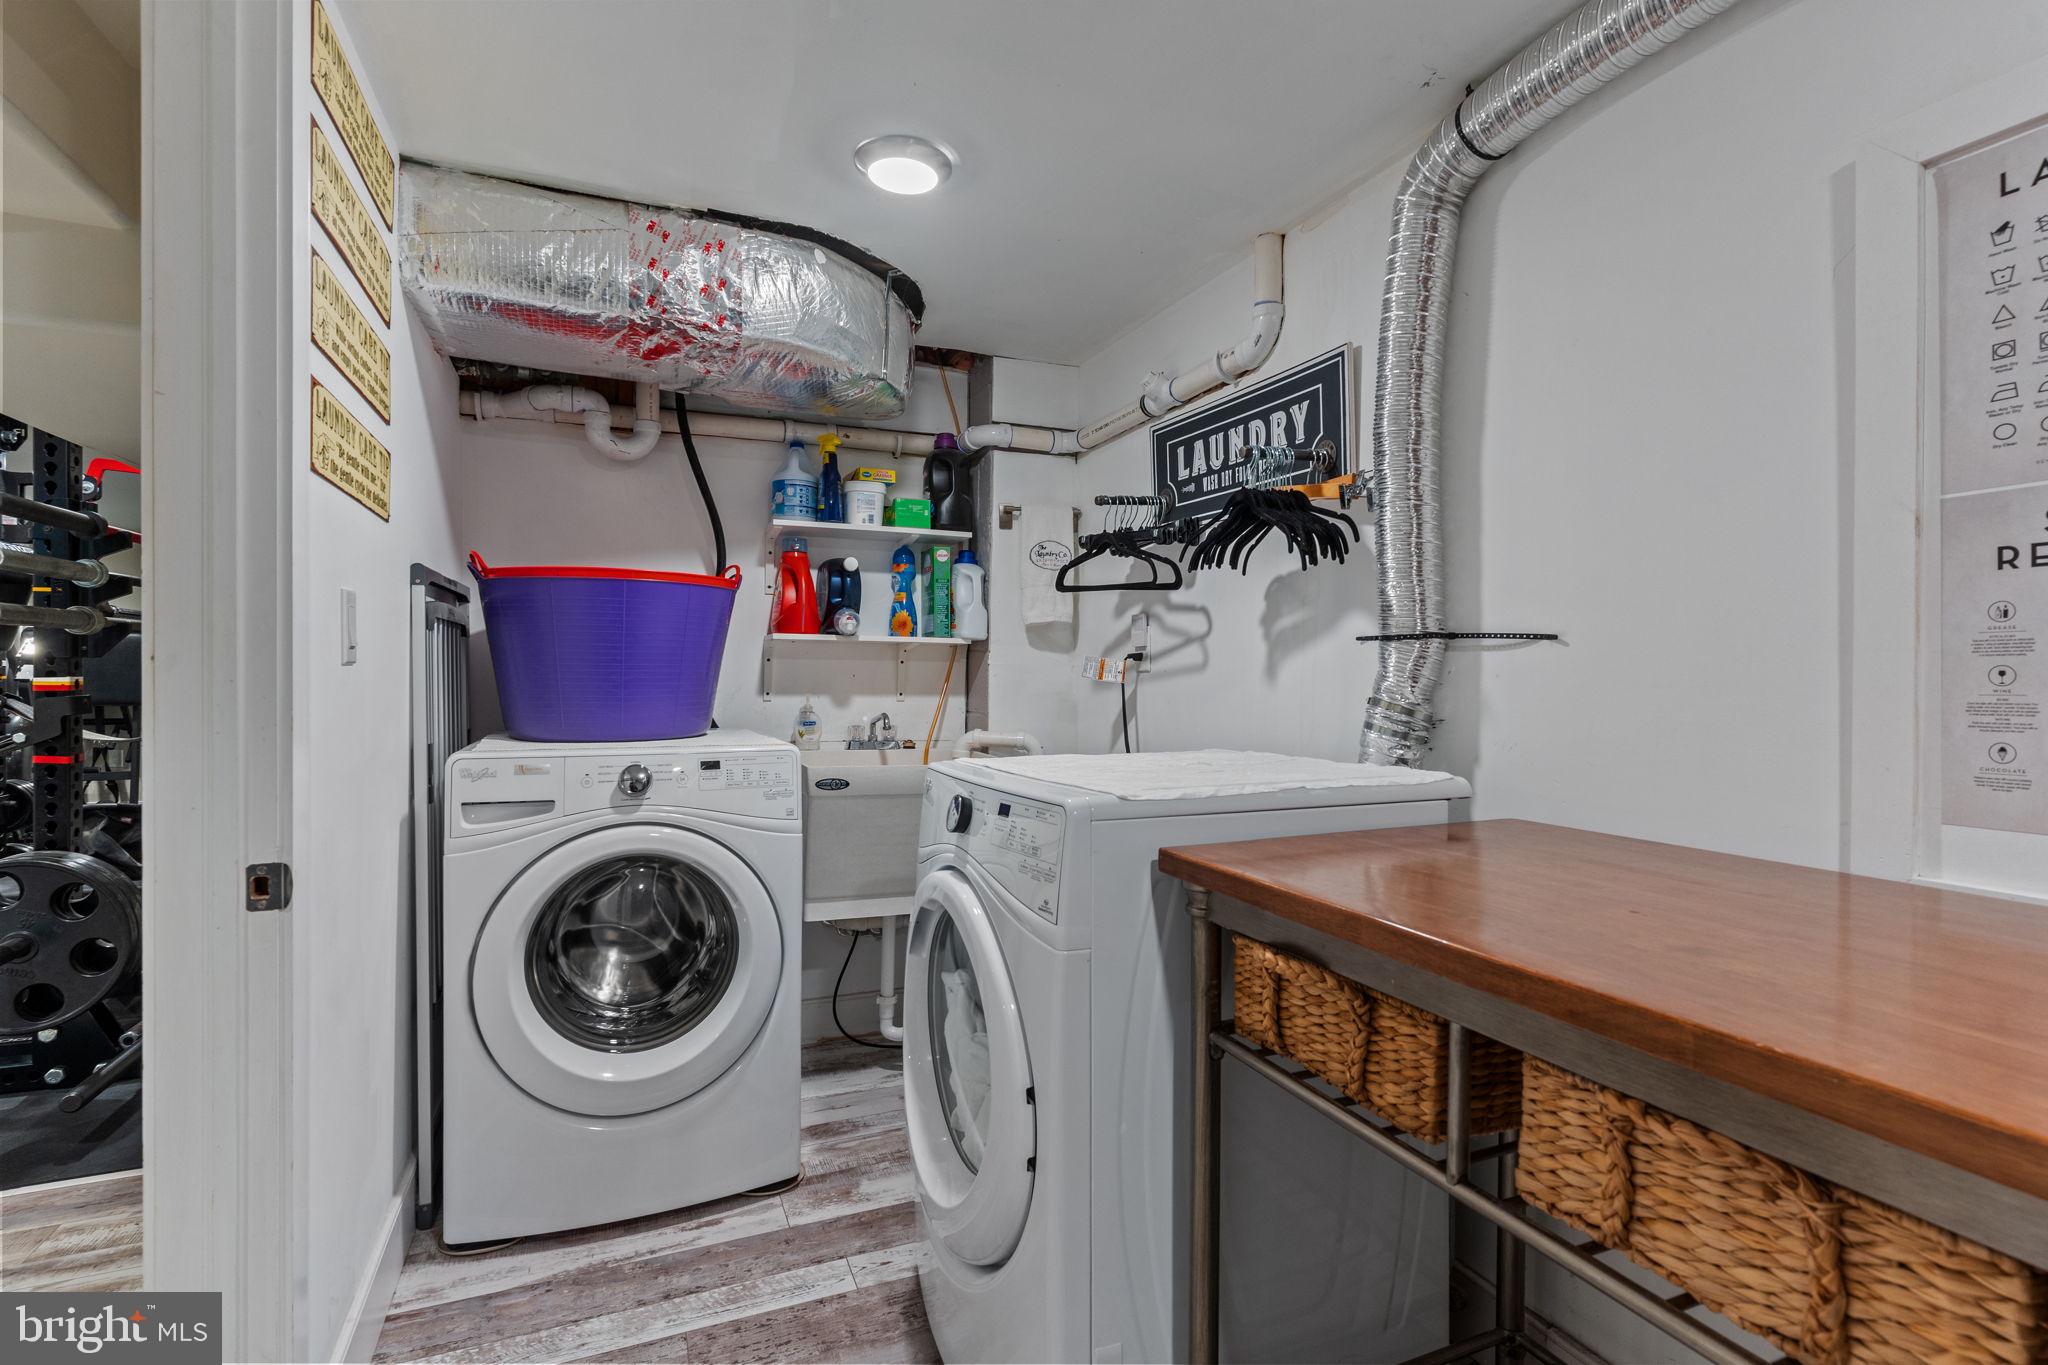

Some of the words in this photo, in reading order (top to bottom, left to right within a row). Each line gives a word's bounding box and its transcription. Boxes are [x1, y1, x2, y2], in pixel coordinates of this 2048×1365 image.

[317, 6, 358, 114] LAUNDRY
[361, 100, 378, 159] CARE
[381, 143, 392, 185] TIP
[314, 129, 355, 225] LAUNDRY
[358, 207, 376, 262] CARE
[379, 244, 389, 283] TIP
[315, 258, 355, 338] LAUNDRY
[358, 318, 377, 365] CARE
[379, 347, 388, 379] TIP
[315, 387, 356, 450] LAUNDRY
[358, 430, 376, 468] CARE
[378, 449, 389, 479] TIP
[1177, 400, 1310, 481] LAUNDRY
[1202, 473, 1219, 492] WASH
[1221, 468, 1233, 487] DRY
